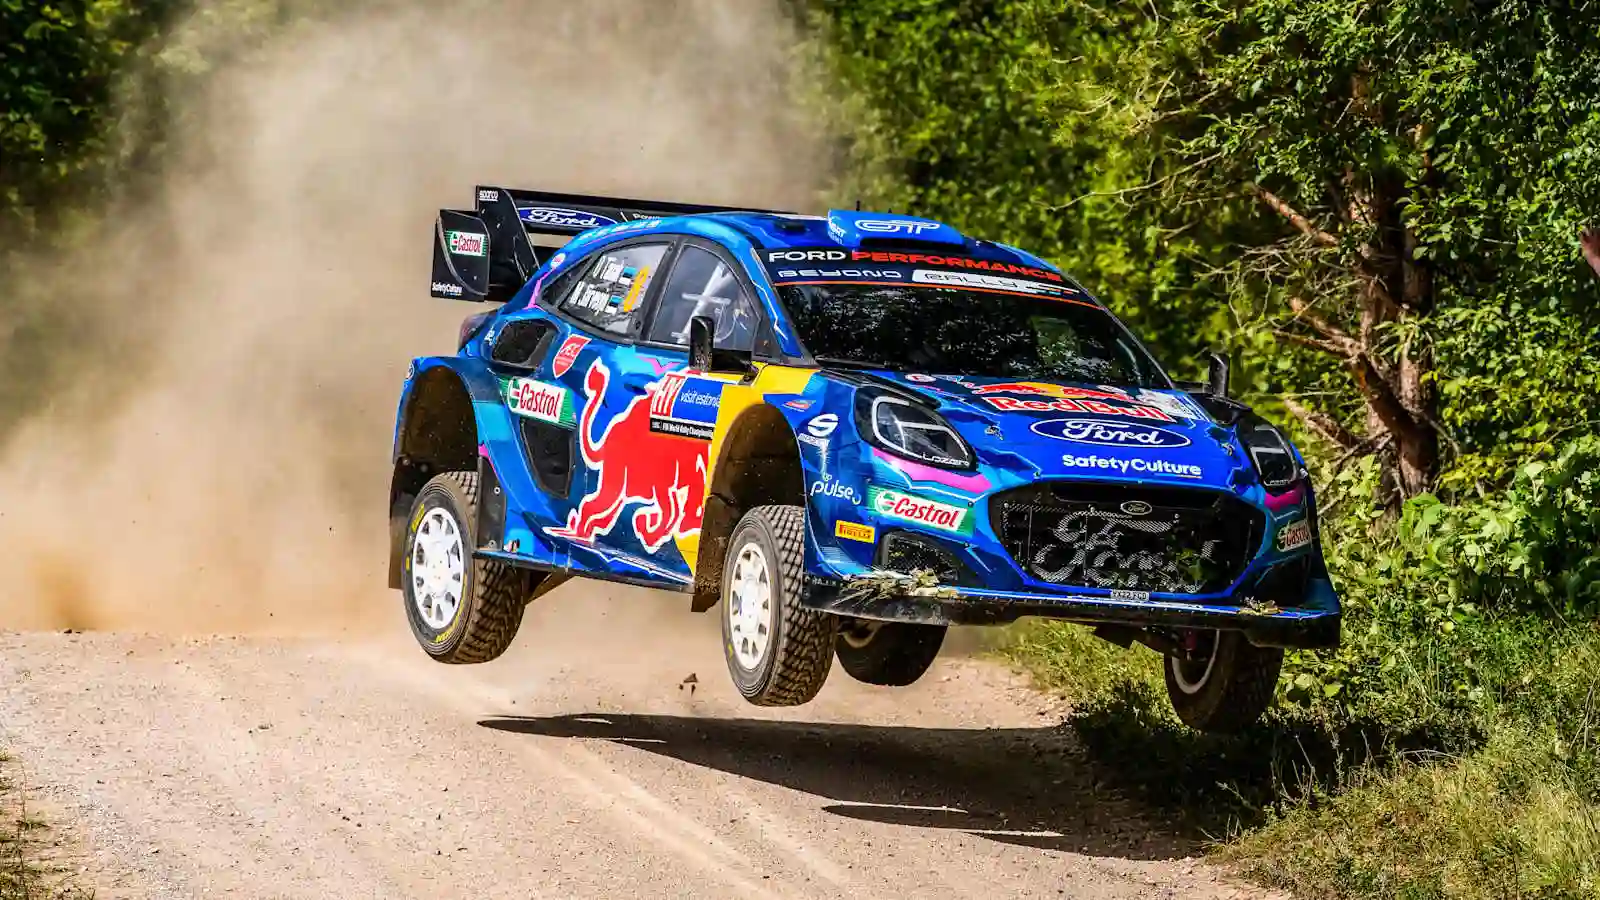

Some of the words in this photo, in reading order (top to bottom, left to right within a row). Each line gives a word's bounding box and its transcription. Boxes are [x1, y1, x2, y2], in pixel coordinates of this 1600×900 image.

[528, 209, 599, 226] Ford
[457, 232, 482, 253] Castrol
[769, 251, 846, 263] FORD
[851, 251, 1062, 282] PERFORMANCE
[778, 269, 902, 278] BEYOND
[519, 383, 561, 423] Castrol
[982, 397, 1082, 411] Red
[1079, 399, 1178, 423] Bull
[1063, 420, 1165, 445] Ford
[1062, 454, 1202, 475] SafetyCulture
[810, 480, 854, 502] pulse
[893, 497, 960, 529] Castrol
